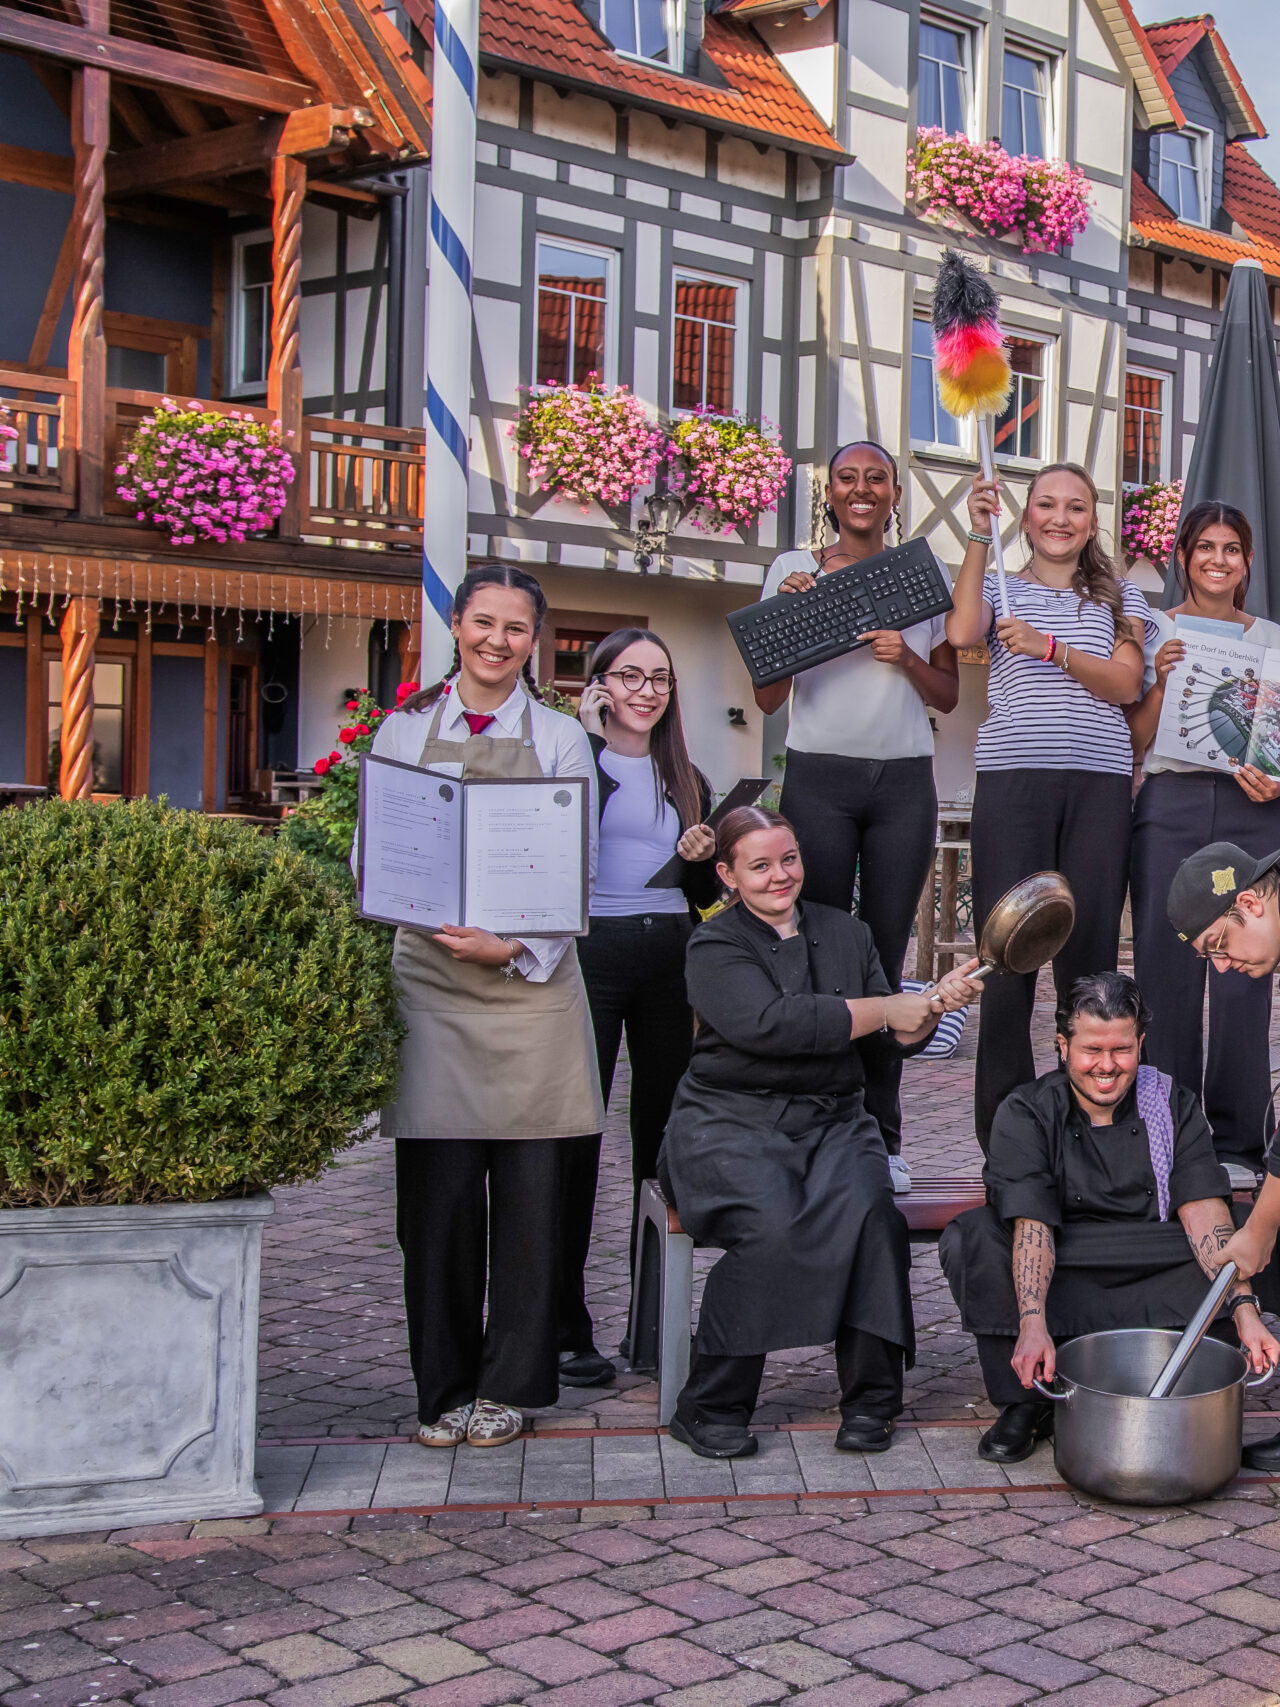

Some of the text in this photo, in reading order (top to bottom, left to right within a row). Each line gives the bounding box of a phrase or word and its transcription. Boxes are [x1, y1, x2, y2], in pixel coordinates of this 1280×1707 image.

[1184, 642, 1199, 650] nser
[1200, 644, 1217, 654] Dorf
[1217, 648, 1227, 656] im
[1228, 649, 1260, 664] Überblick
